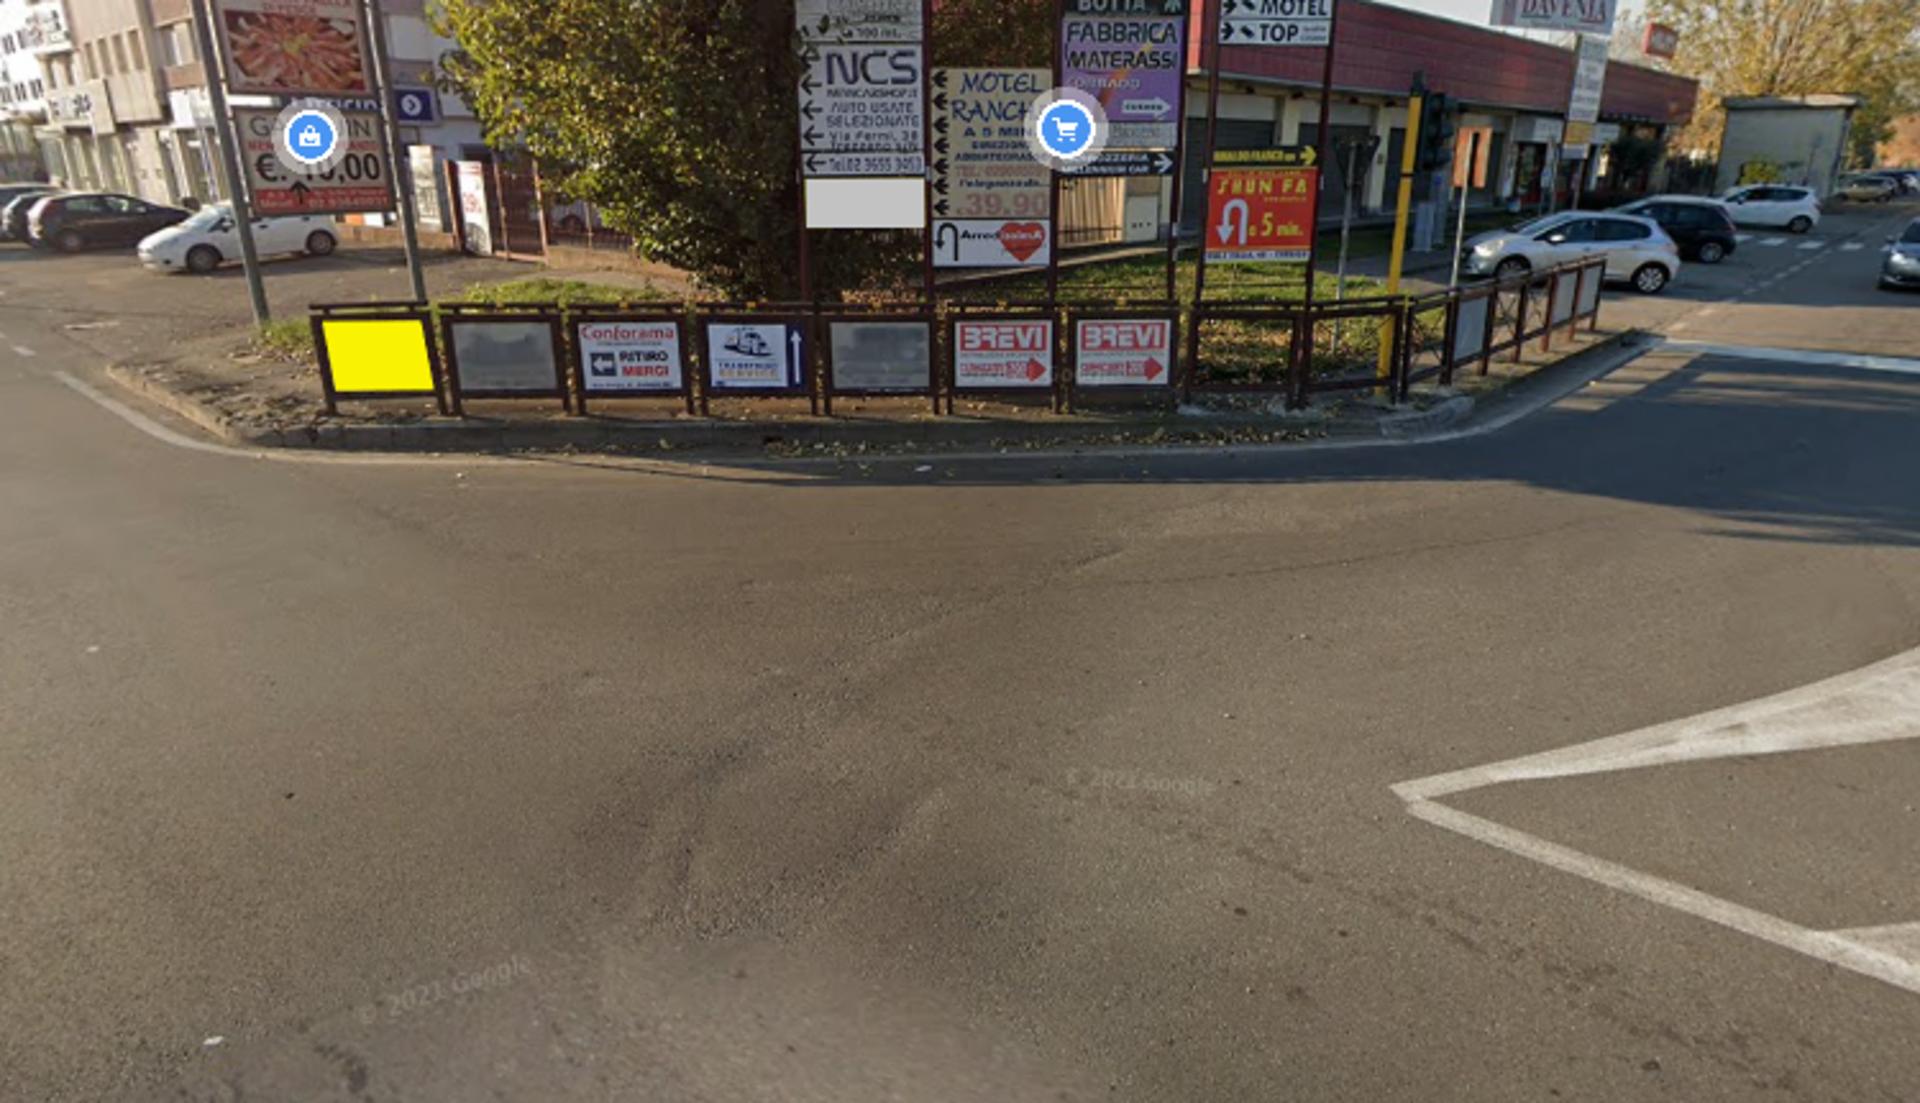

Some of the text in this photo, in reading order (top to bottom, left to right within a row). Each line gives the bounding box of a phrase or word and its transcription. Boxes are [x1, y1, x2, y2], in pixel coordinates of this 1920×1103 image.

[1260, 0, 1328, 16] MOTEL
[1067, 21, 1178, 43] FABBRICA
[1259, 24, 1299, 42] TOP
[826, 50, 918, 85] NCS
[1066, 50, 1179, 69] MATERASSI
[960, 71, 1046, 94] MOTEL
[832, 101, 914, 114] AUTO USATE
[964, 127, 976, 137] A
[1260, 211, 1274, 237] 5
[580, 325, 675, 341] Conforama
[964, 326, 1043, 349] BREVI
[1084, 325, 1161, 348] BREVI
